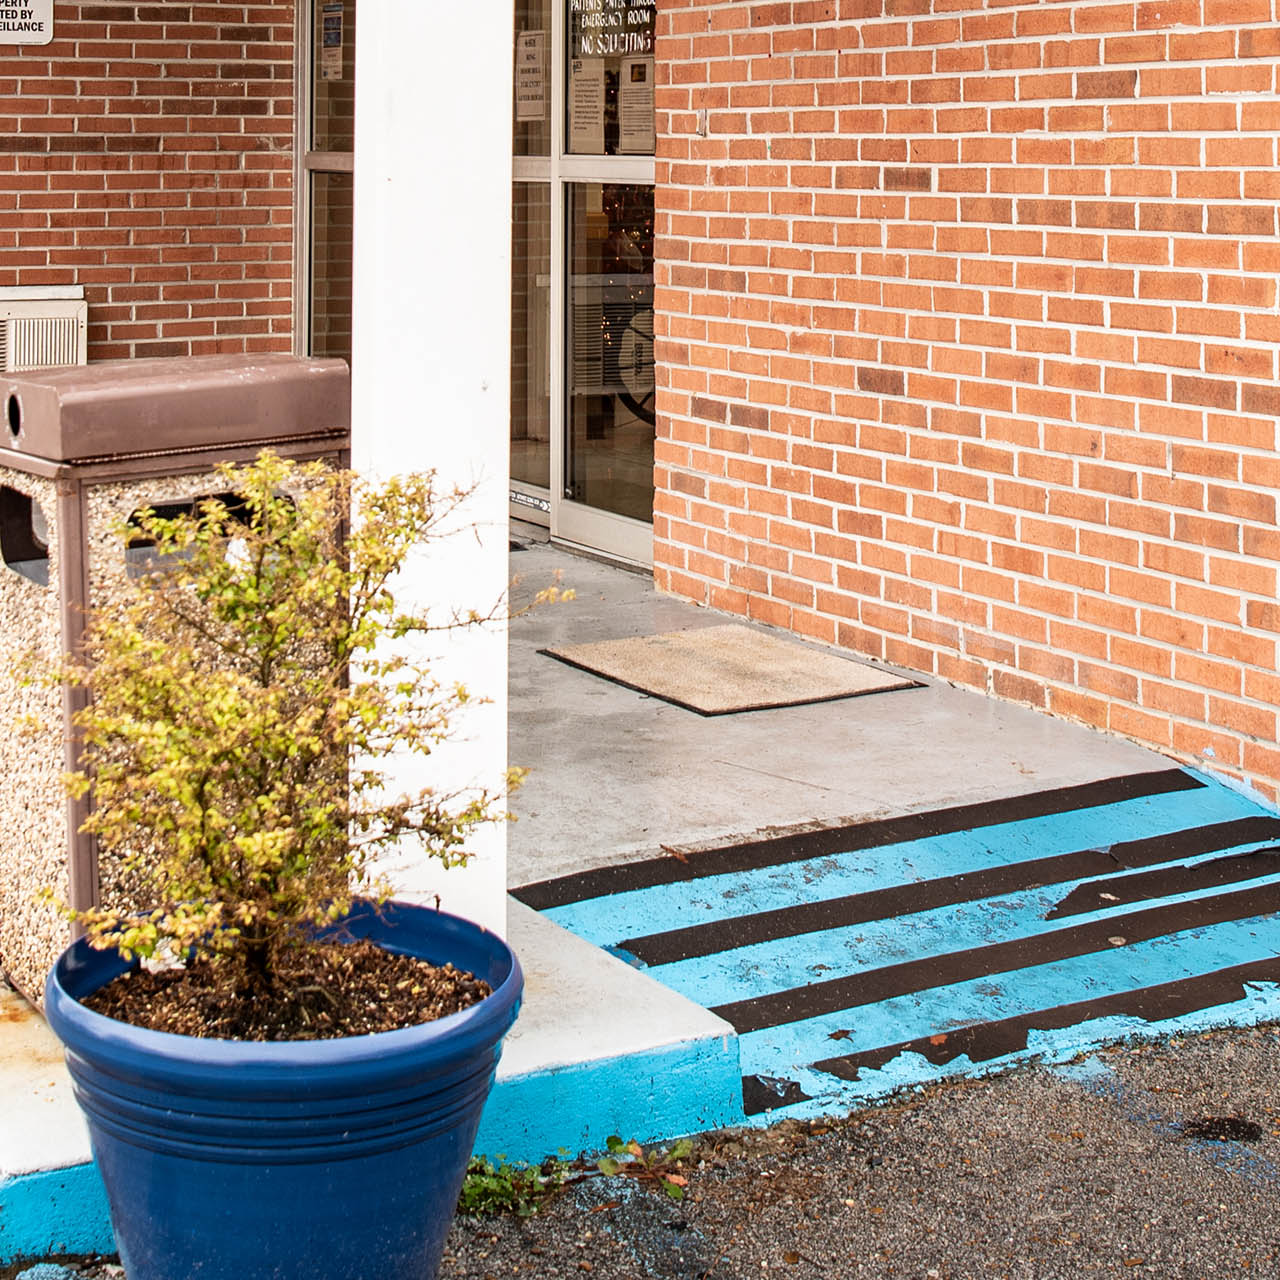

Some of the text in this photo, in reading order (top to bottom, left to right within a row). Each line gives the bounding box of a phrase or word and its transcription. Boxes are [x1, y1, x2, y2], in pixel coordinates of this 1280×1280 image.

[20, 10, 34, 20] BY
[581, 9, 651, 29] EMERGENCY ROOM
[581, 35, 593, 55] NO
